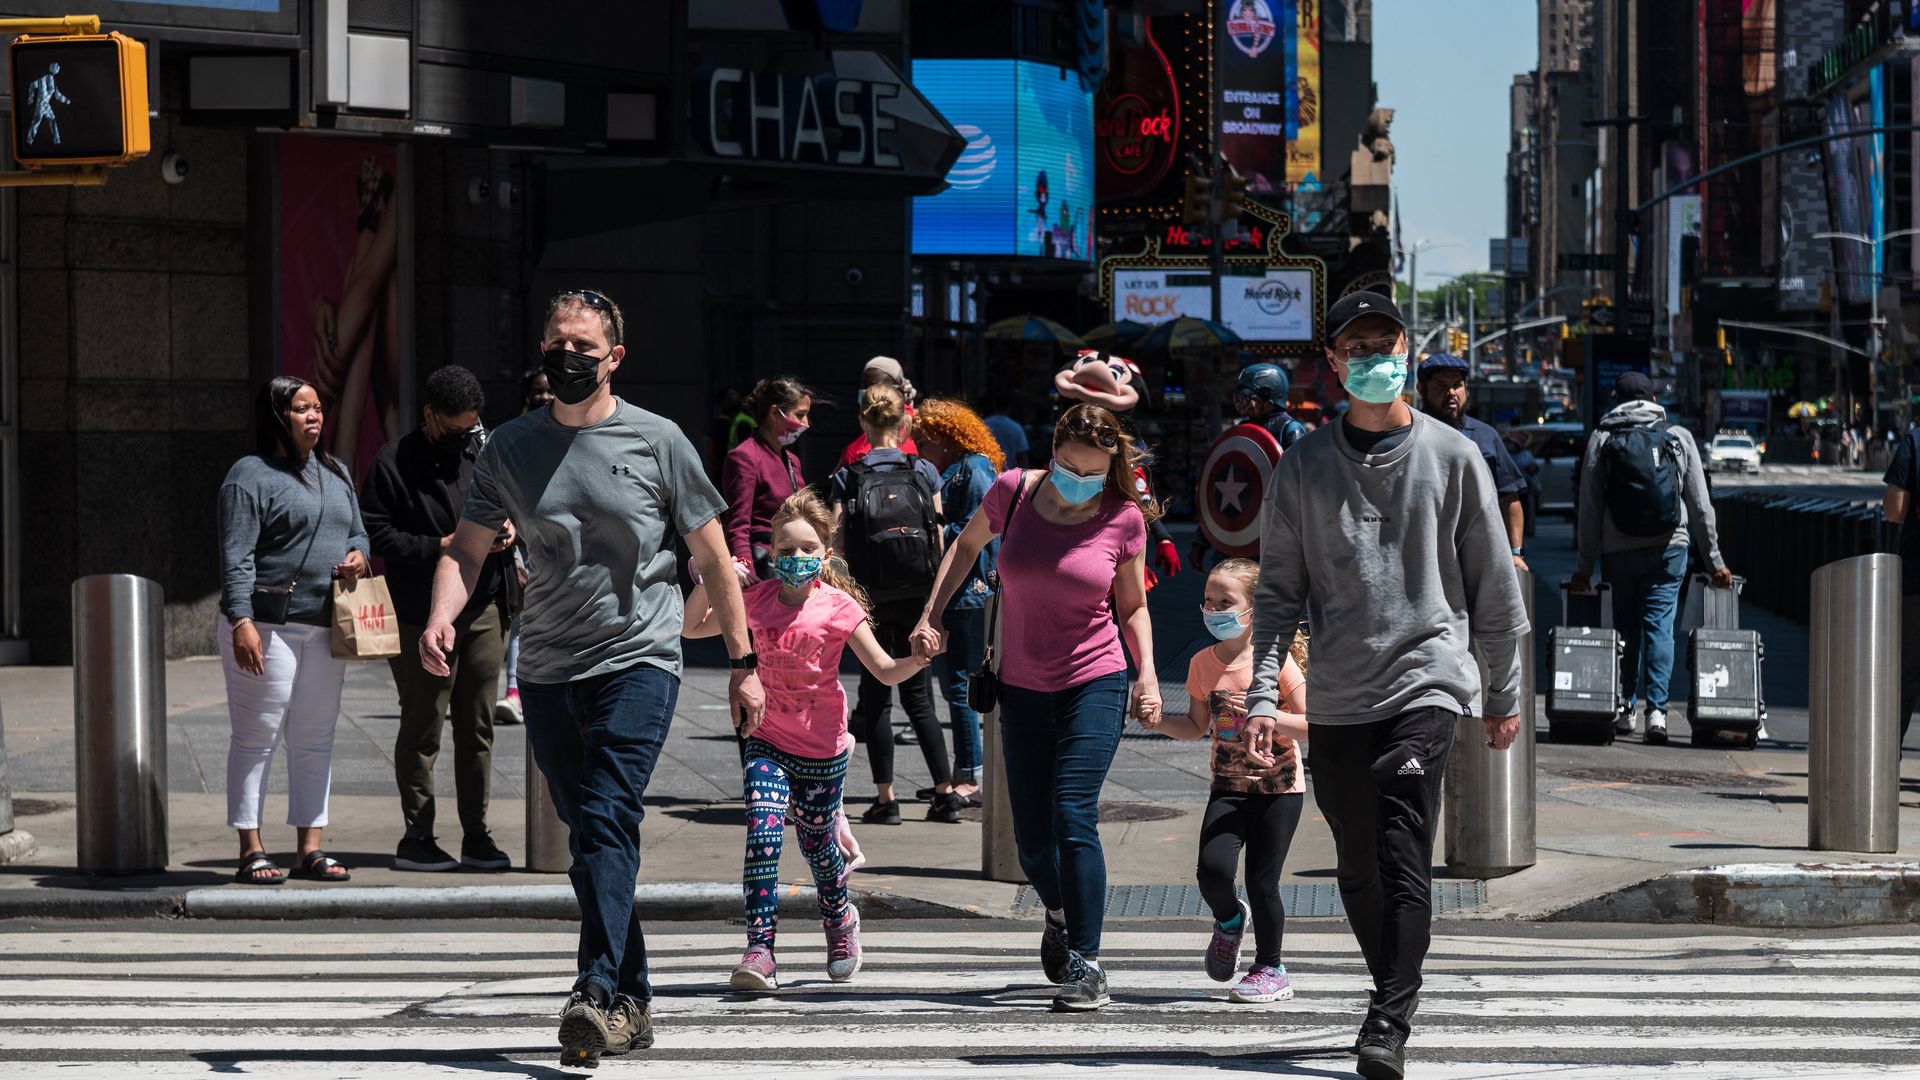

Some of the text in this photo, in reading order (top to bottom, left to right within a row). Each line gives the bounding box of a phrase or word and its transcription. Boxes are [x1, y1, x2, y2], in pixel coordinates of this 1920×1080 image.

[1223, 89, 1280, 105] ENTRANCE
[709, 67, 902, 167] CHASE
[1243, 106, 1261, 120] ON
[1222, 121, 1282, 136] BROADWAY
[1124, 281, 1142, 289] LET
[1145, 281, 1158, 289] US
[1244, 287, 1302, 302] Hard Rock
[1126, 293, 1179, 317] ROCK
[357, 603, 385, 631] H&M
[1568, 639, 1602, 647] PELICAN
[1709, 641, 1743, 650] PELICAN
[1397, 767, 1425, 776] adidas
